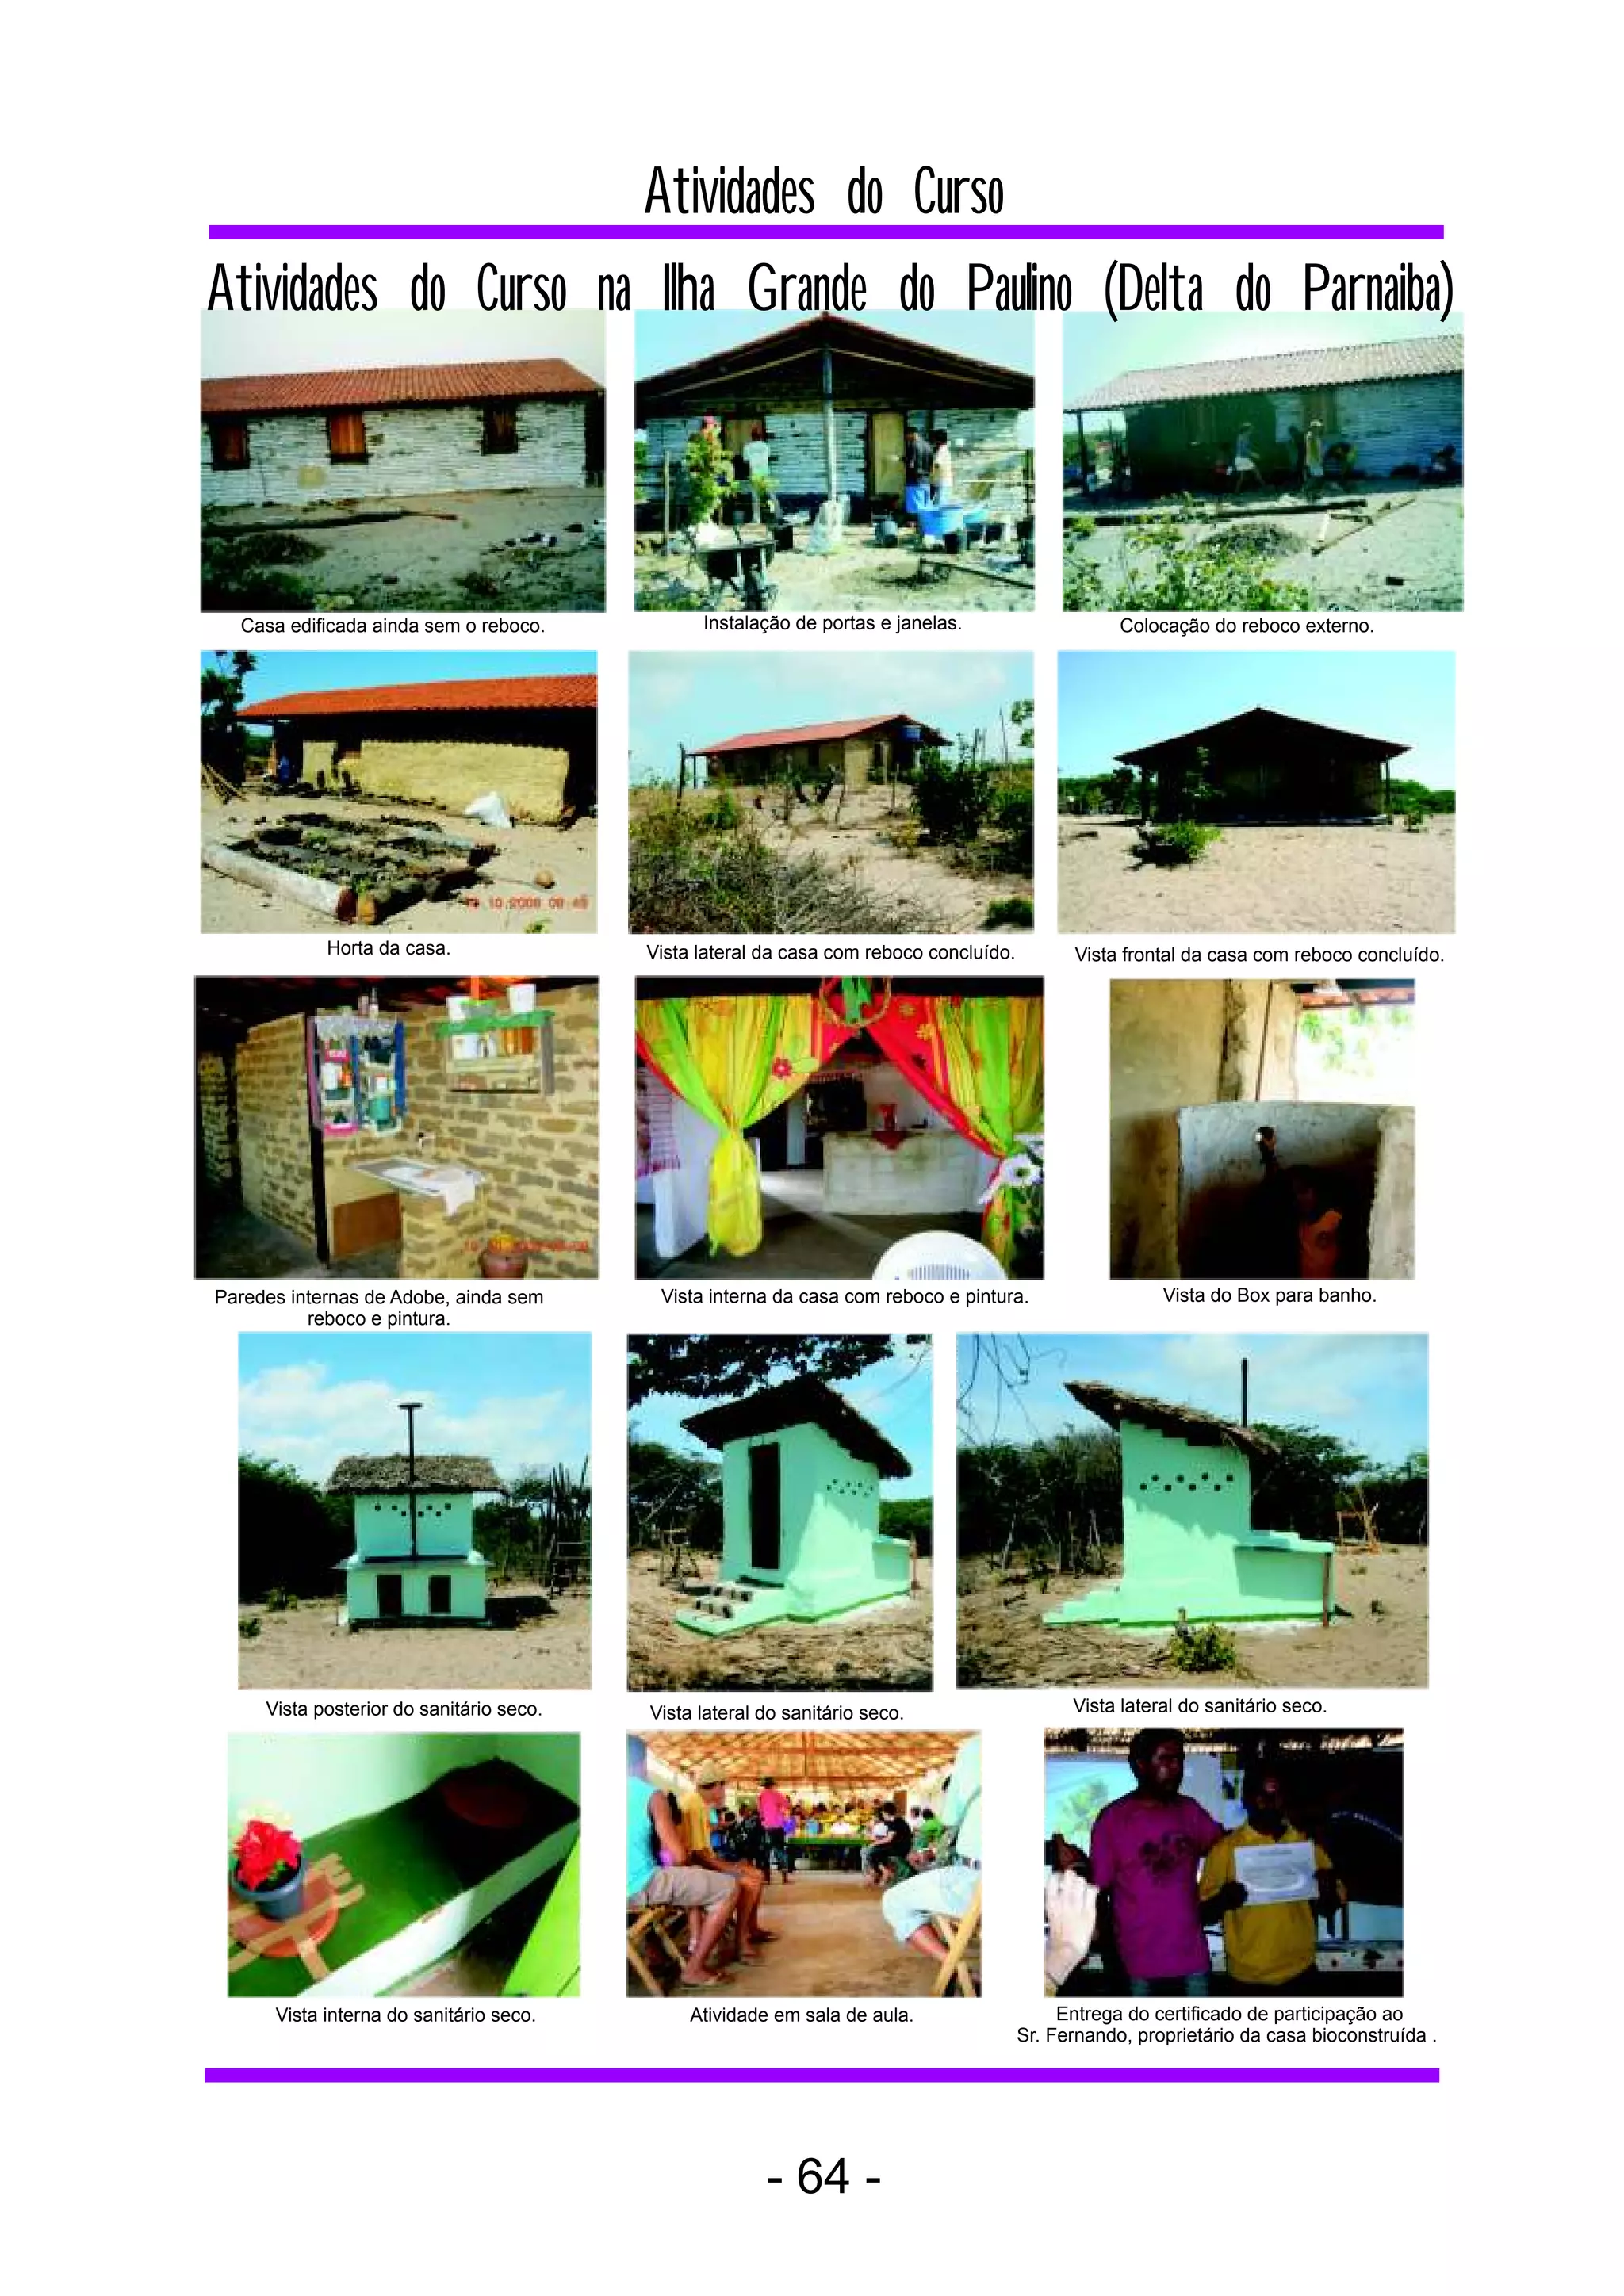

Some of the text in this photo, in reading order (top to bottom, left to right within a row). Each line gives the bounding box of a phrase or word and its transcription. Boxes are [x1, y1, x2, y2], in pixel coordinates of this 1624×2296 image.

[644, 165, 1004, 215] Atividades do Curso
[207, 259, 1454, 323] Atividades do Curso na Ilha Grande do Paulino (Delta do Parnaiba)
[241, 618, 545, 633] Casa edificada ainda sem o reboco.
[704, 614, 962, 634] Instalação de portas e janelas.
[1120, 618, 1374, 637] Colocação do reboco externo.
[327, 939, 450, 955] Horta da casa.
[646, 944, 1015, 960] Vista lateral da casa com reboco concluído.
[1074, 947, 1444, 962] Vista frontal da casa com reboco concluído.
[215, 1289, 543, 1307] Paredes internas de Adobe, ainda sem
[661, 1288, 1028, 1307] Vista interna da casa com reboco e pintura.
[1162, 1287, 1377, 1307] Vista do Box para banho.
[308, 1311, 450, 1330] reboco e pintura.
[266, 1701, 542, 1720] Vista posterior do sanitário seco.
[649, 1705, 904, 1720] Vista lateral do sanitário seco.
[1073, 1697, 1327, 1713] Vista lateral do sanitário seco.
[275, 2007, 535, 2022] Vista interna do sanitário seco.
[690, 2007, 914, 2022] Atividade em sala de aula.
[1057, 2005, 1404, 2026] Entrega do certificado de participação ao
[1017, 2026, 1040, 2043] Sr.
[1046, 2027, 1132, 2045] Fernando,
[1138, 2027, 1235, 2046] proprietário
[1239, 2027, 1261, 2043] da
[1266, 2030, 1307, 2043] casa
[1312, 2026, 1427, 2043] bioconstruída
[798, 2157, 850, 2195] 64
